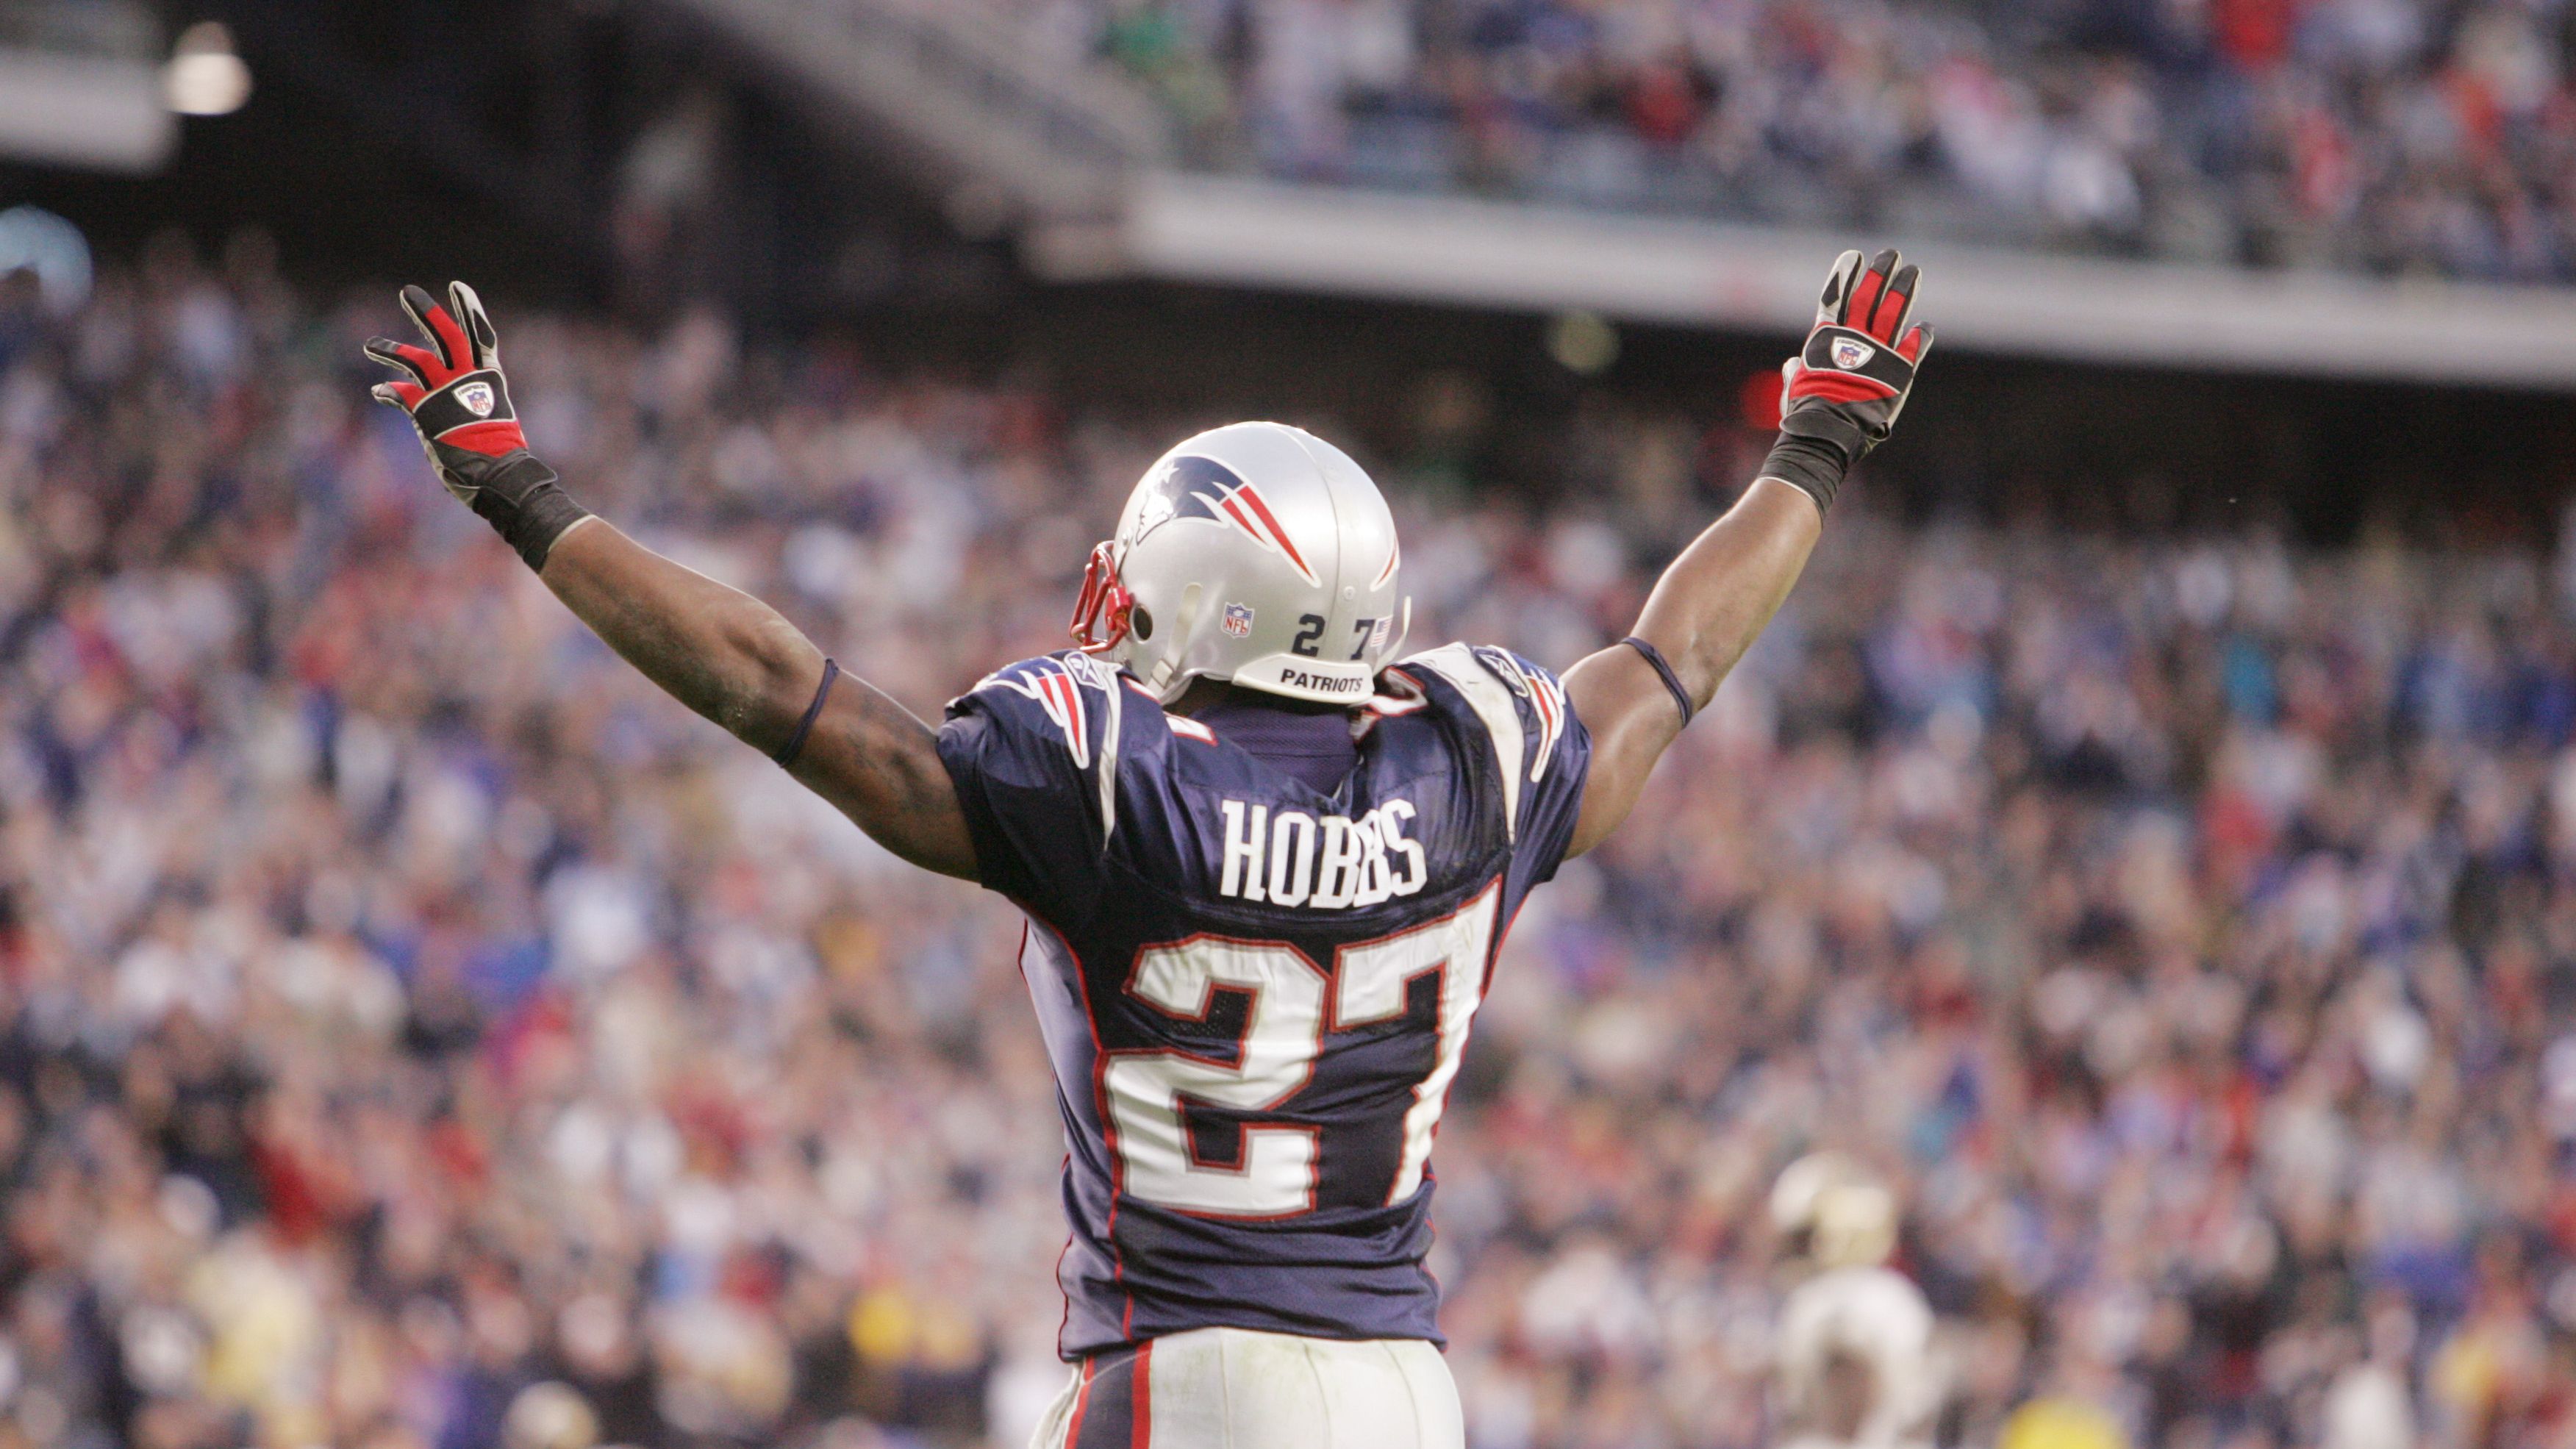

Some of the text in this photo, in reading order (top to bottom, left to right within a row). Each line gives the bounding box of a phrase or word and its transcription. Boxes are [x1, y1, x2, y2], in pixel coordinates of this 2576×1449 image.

[1225, 616, 1248, 634] NFL
[1281, 668, 1363, 693] PATRIOTS
[1220, 798, 1427, 909] HOBBS
[1093, 873, 1502, 1222] 27
